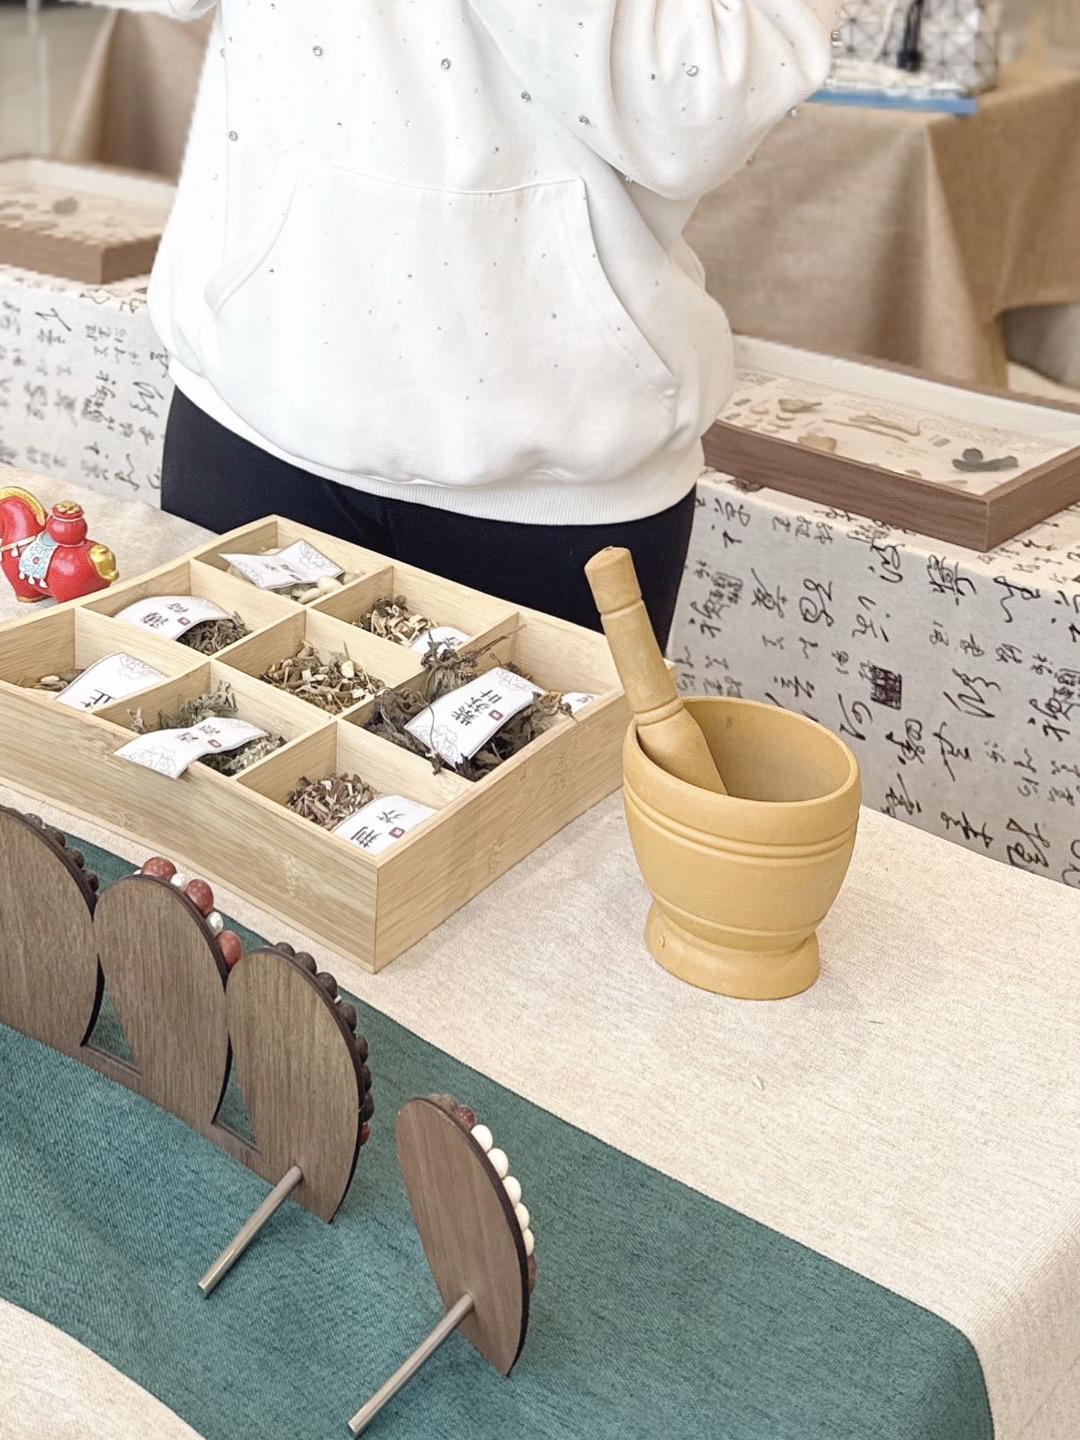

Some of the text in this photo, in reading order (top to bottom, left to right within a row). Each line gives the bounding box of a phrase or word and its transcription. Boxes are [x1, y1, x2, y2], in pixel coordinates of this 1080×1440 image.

[449, 689, 504, 726] 紫苏叶
[350, 809, 407, 848] 荆芥
